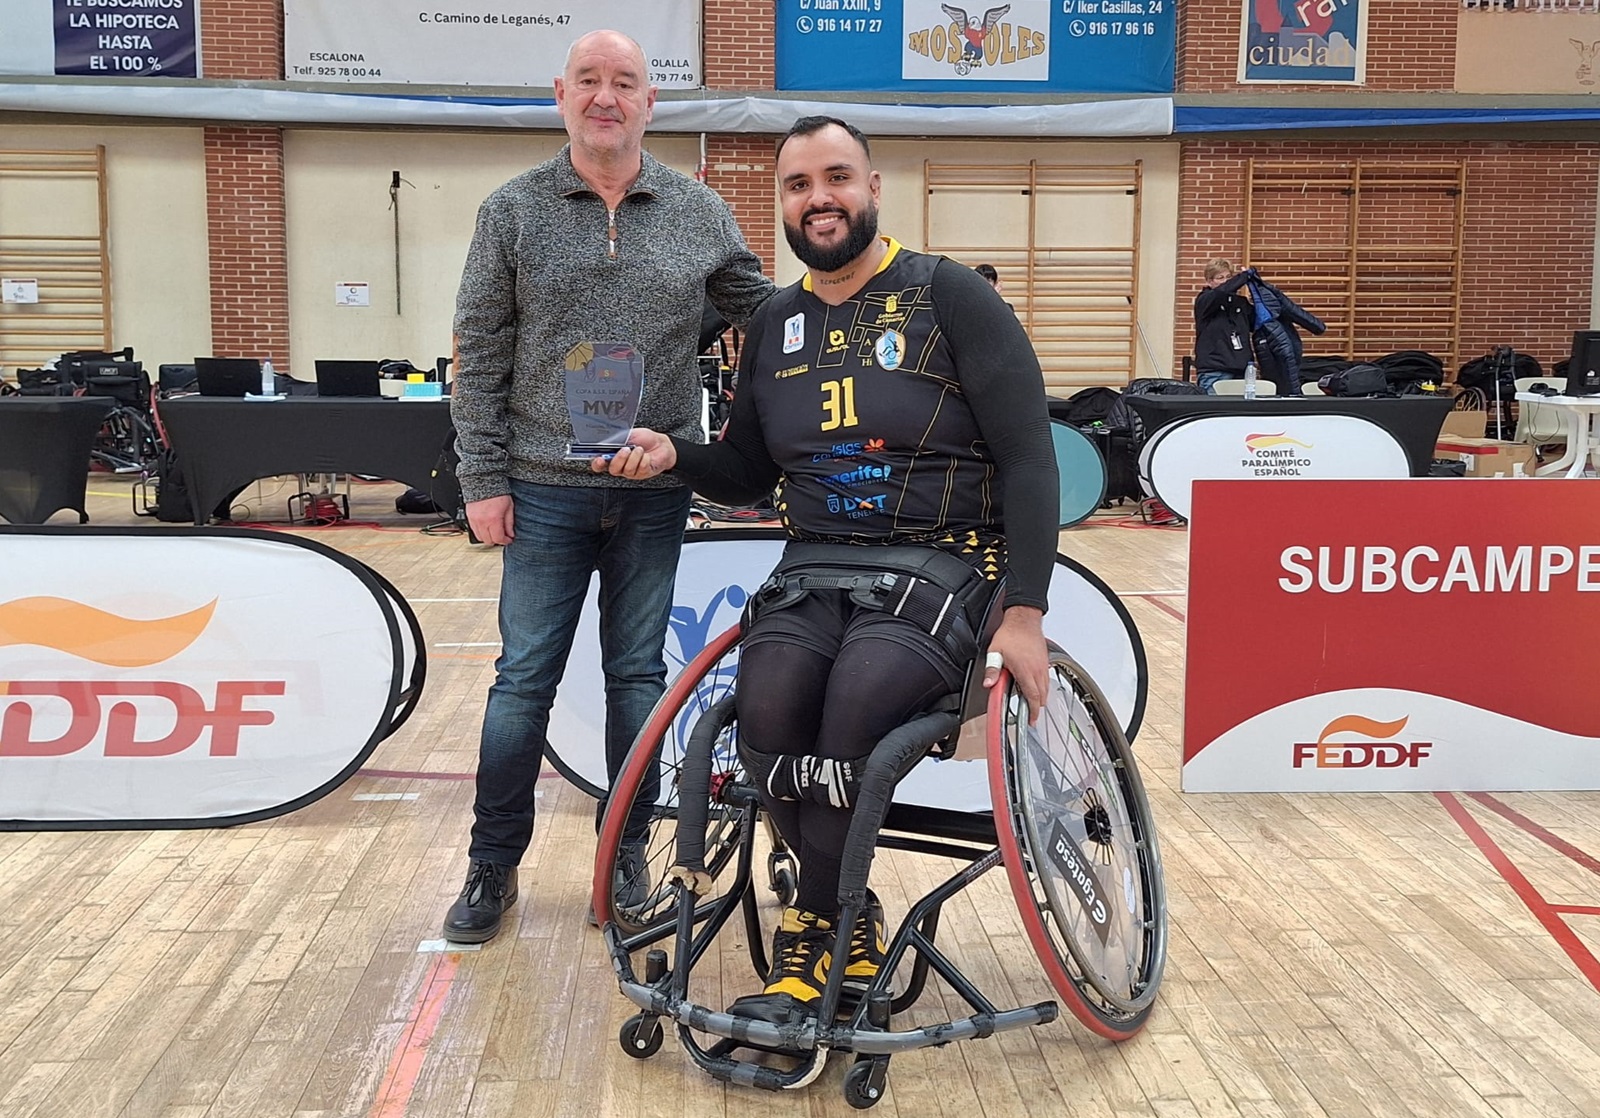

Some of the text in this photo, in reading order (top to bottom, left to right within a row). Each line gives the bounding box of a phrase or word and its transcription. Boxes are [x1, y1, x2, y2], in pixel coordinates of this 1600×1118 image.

[814, 0, 839, 10] Juan
[874, 0, 881, 11] 9
[1063, 0, 1163, 16] C/ Iker Casillas, 24
[69, 13, 179, 29] LA HIPOTECA
[419, 12, 571, 27] C. Camino de Leganés, 47
[817, 18, 882, 32] 916 14 17 27
[1089, 22, 1154, 35] 916 17 96 16
[98, 35, 152, 50] HASTA
[309, 52, 365, 62] ESCALONA
[1249, 38, 1349, 66] ciudad
[90, 56, 162, 71] EL 100 %
[651, 58, 690, 68] OLALLA
[293, 66, 381, 77] Telf. 925 78 00 44
[655, 73, 667, 82] 79
[669, 73, 679, 82] 77
[681, 73, 693, 82] 49
[582, 400, 626, 415] MVP
[821, 376, 859, 432] 31
[1256, 448, 1295, 458] COMITÉ
[1242, 458, 1311, 467] PARALÍMPICO
[1254, 467, 1301, 476] ESPAÑOL
[843, 494, 887, 511] DXT
[1278, 545, 1600, 593] SUBCAMPE
[0, 681, 286, 757] DDF
[1293, 742, 1433, 768] FEDDF
[1055, 839, 1096, 906] Egatesa
